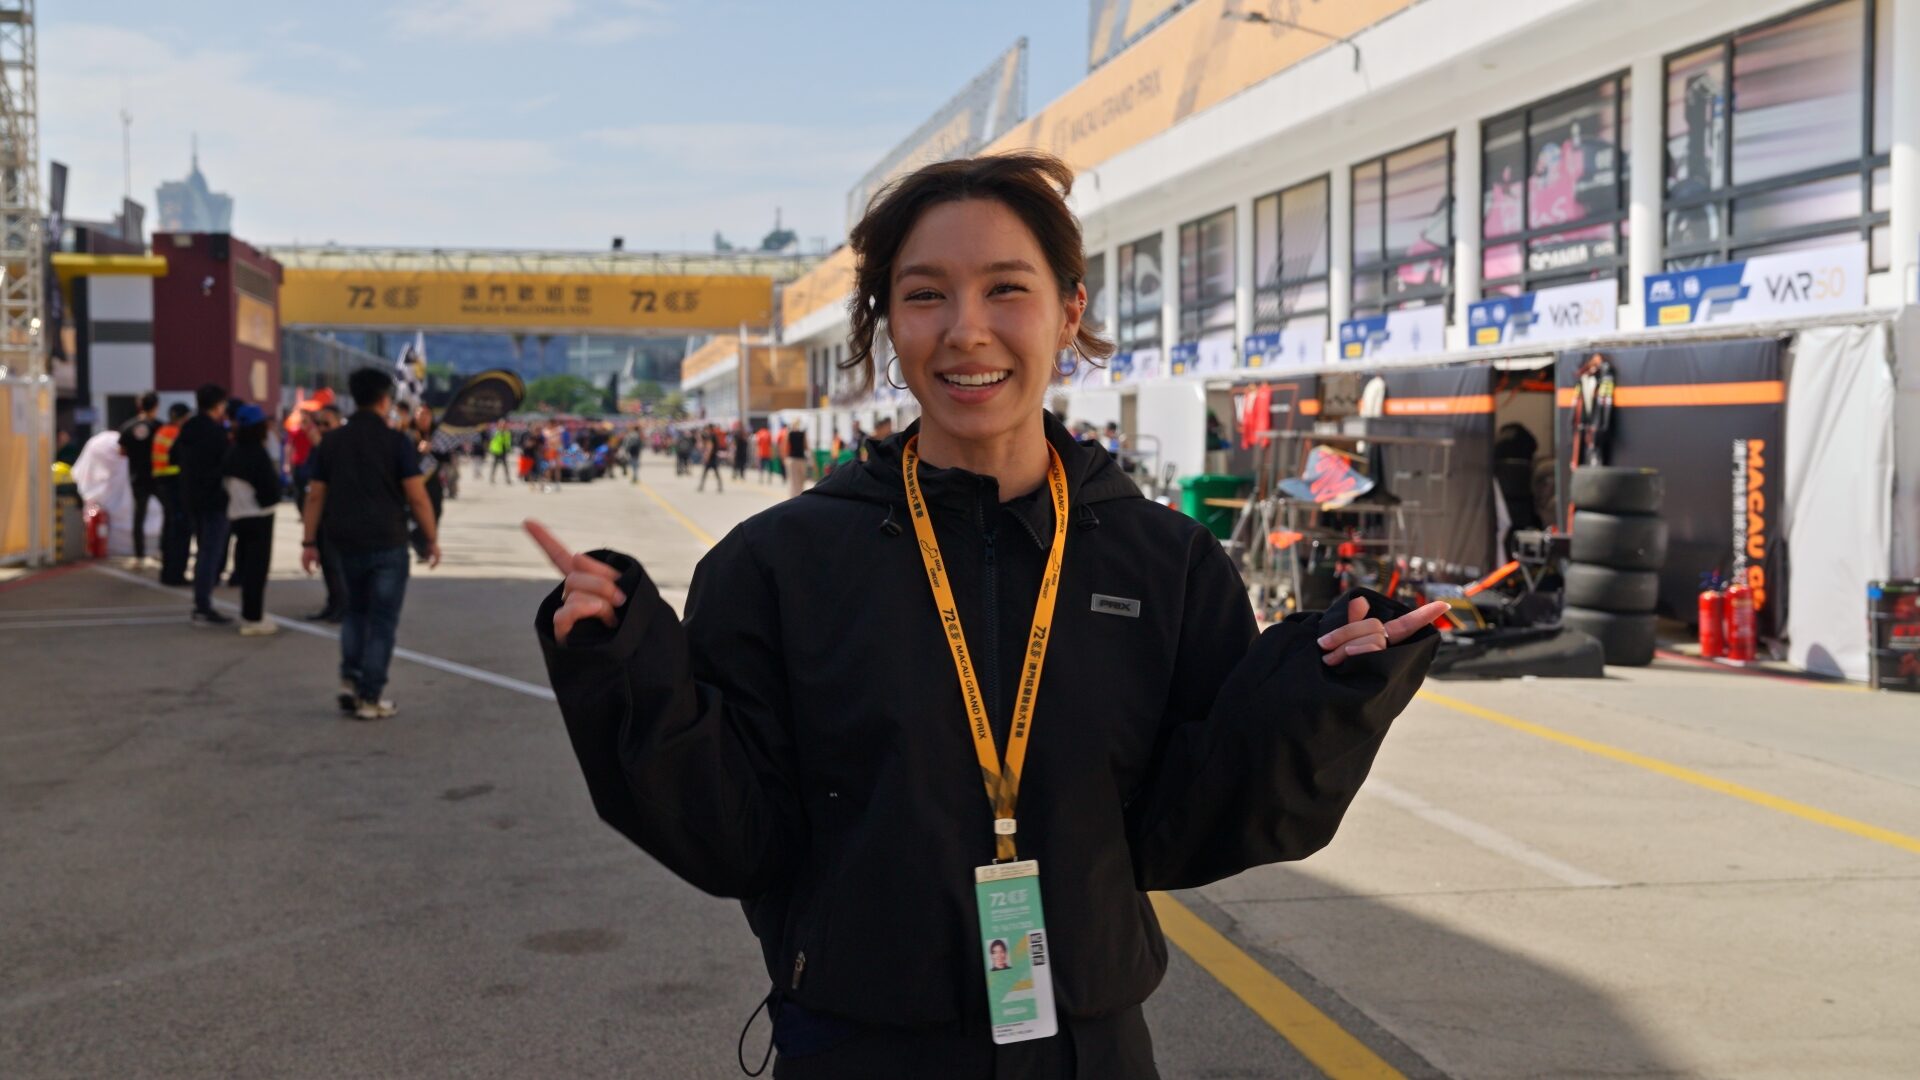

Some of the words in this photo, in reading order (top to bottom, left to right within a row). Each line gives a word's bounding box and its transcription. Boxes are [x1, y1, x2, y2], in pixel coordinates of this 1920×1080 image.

[347, 284, 377, 310] 72
[630, 290, 658, 312] 72
[1055, 482, 1065, 511] GRAND
[1747, 438, 1766, 560] MACAU
[929, 568, 940, 588] CIRCUIT
[1033, 625, 1047, 640] 72
[942, 607, 956, 623] 72
[955, 645, 971, 678] MACAU
[965, 680, 980, 715] GRAND
[974, 716, 986, 740] PRIX
[989, 891, 1007, 907] 72
